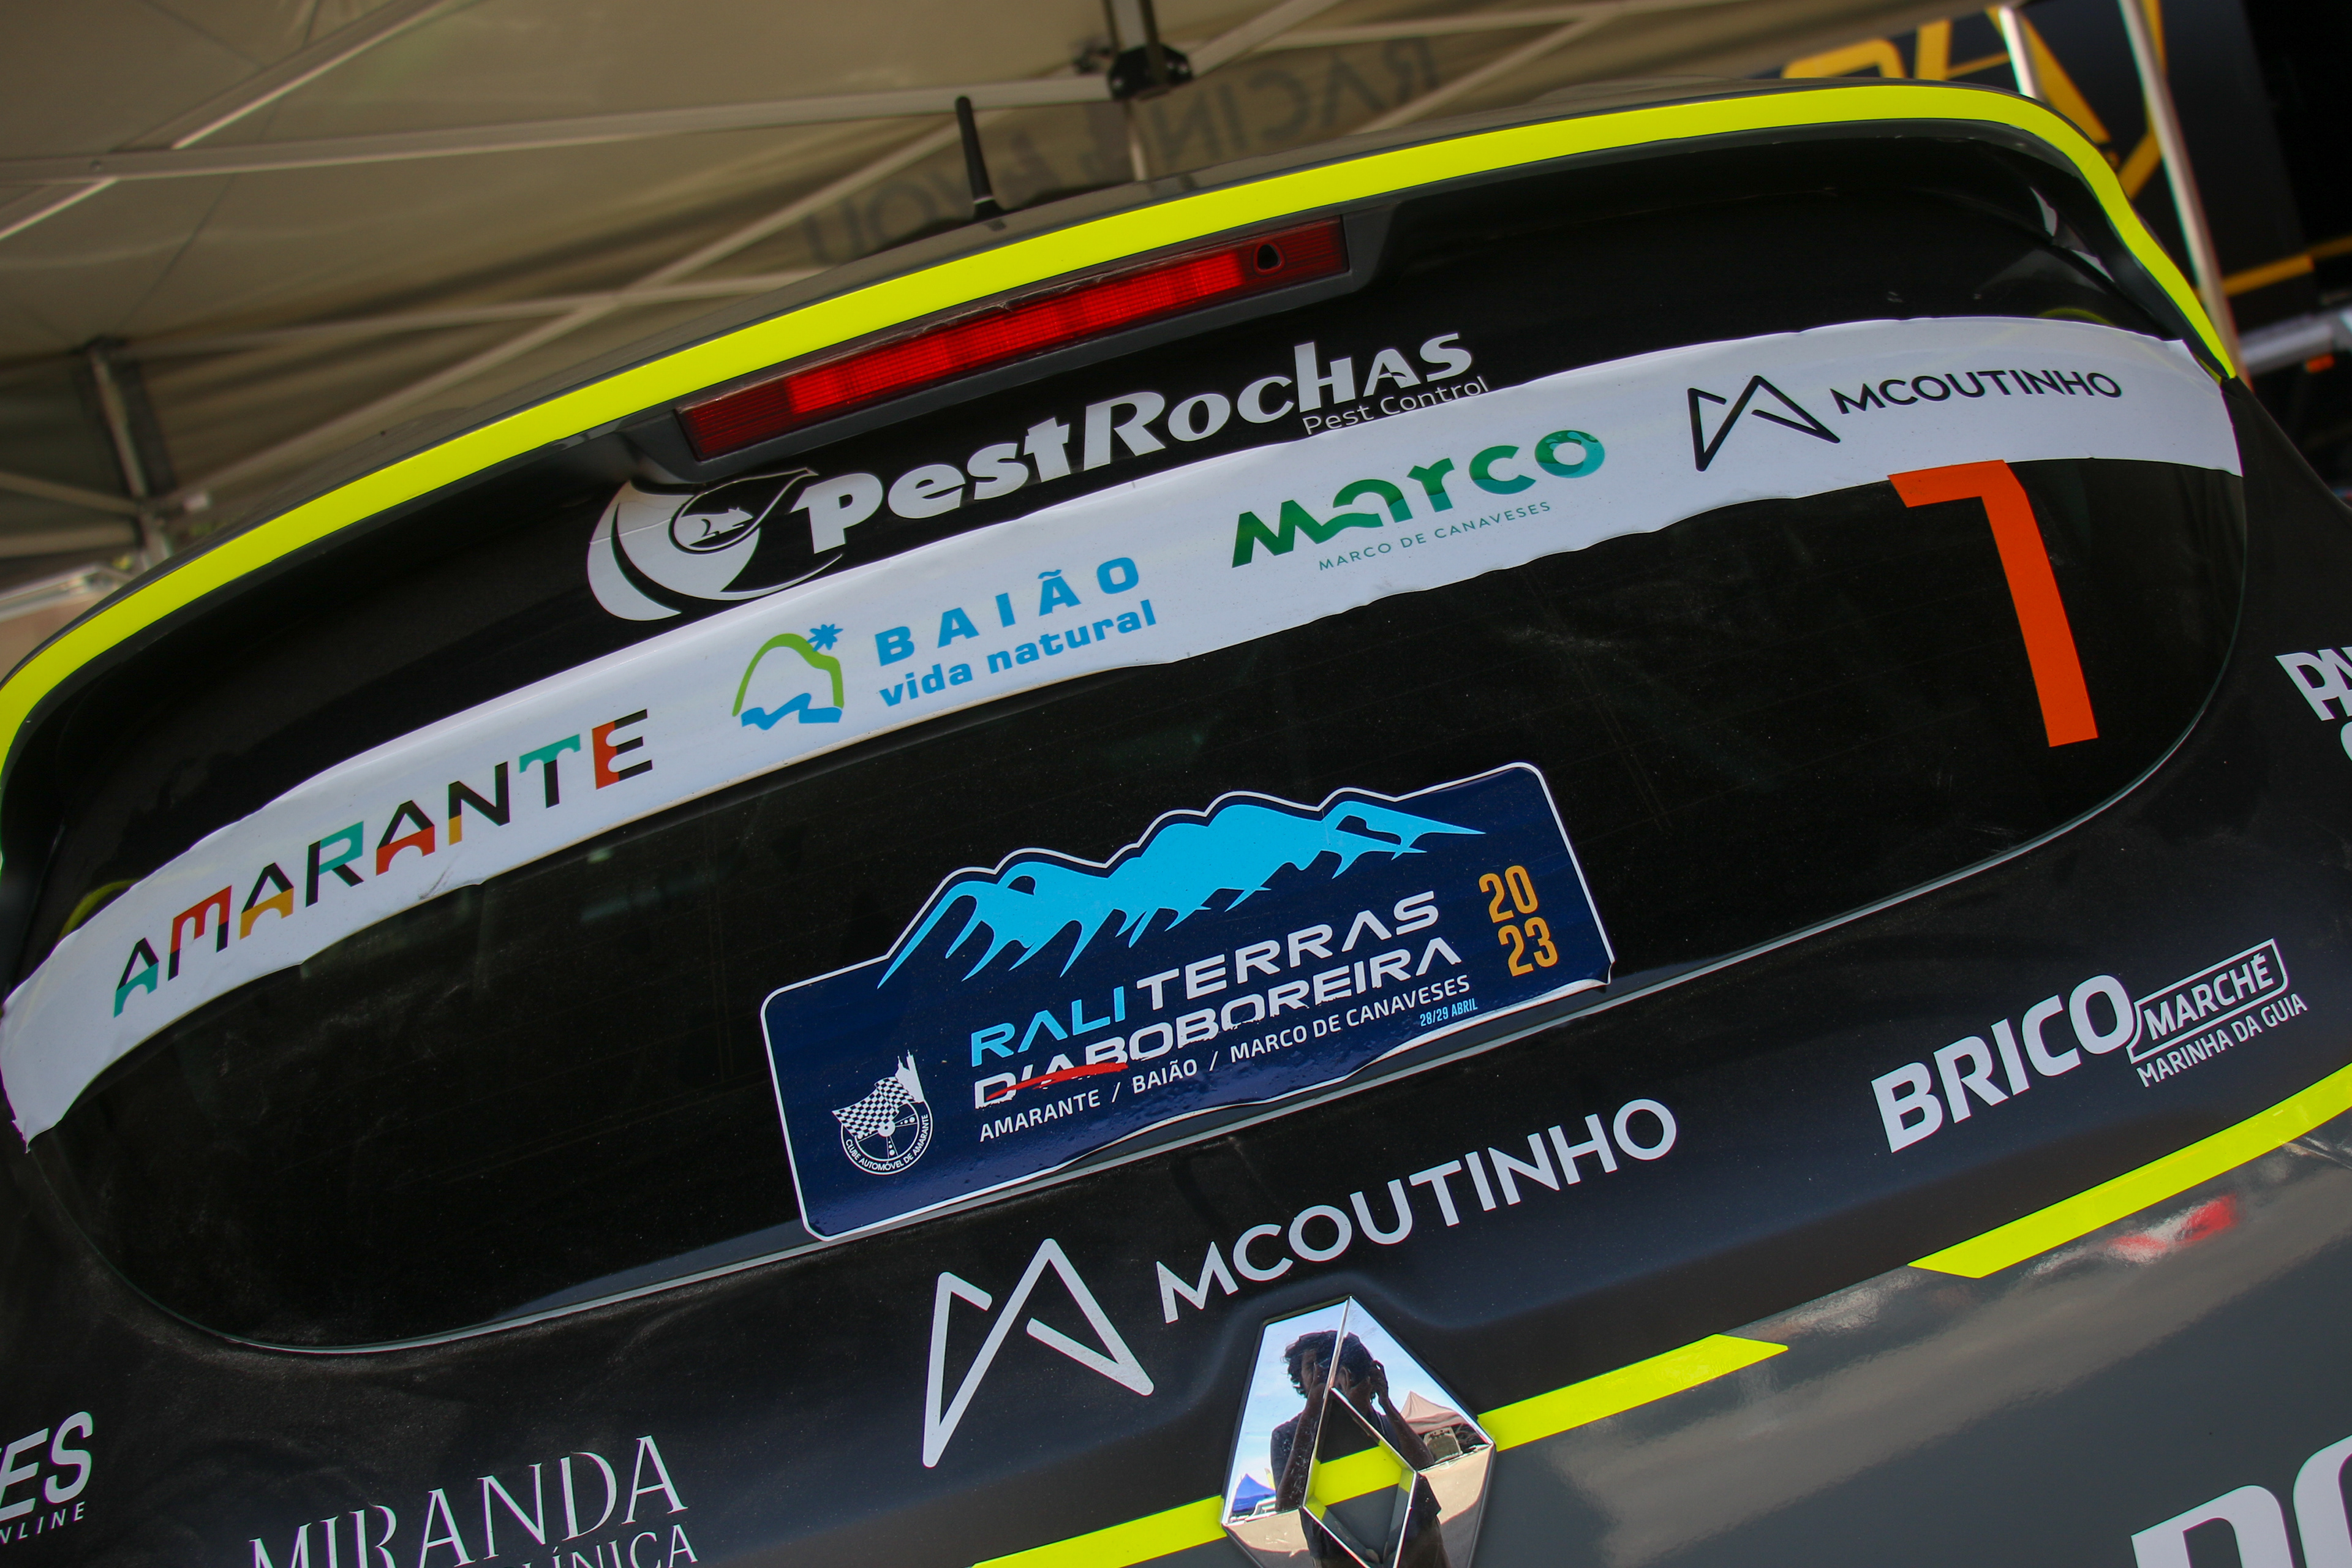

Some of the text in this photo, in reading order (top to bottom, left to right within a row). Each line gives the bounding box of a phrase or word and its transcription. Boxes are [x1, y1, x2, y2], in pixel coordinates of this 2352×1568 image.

[1302, 376, 1489, 435] Pest Control
[1830, 369, 2122, 415] MCOUTINHO
[1319, 501, 1551, 571] MARCO DE CANAVESES
[875, 557, 1139, 666] BAIÃO
[879, 599, 1156, 707] vida natural
[1887, 459, 2098, 747] 7
[2275, 646, 2352, 721] PA
[113, 709, 654, 1019] AMARANTE
[1479, 865, 1538, 923] 20
[971, 890, 1440, 1068] RALI TERRAS
[1498, 917, 1558, 977] 23
[979, 1089, 1101, 1142] AMARANTE
[1132, 1059, 1197, 1094] BAIÃO
[1230, 1025, 1308, 1063] MARCO
[1313, 1014, 1341, 1038] DE
[1346, 974, 1470, 1027] CANAVESES
[1419, 998, 1479, 1027] 28/29 ABRIL
[1871, 952, 2274, 1153] BRICO MARCHÉ
[2136, 993, 2308, 1088] MARINHA DA GUIA
[845, 1114, 929, 1172] CLUBE AUTOMÓVEL DE AMARANTE
[1156, 1098, 1677, 1324] MCOUTINHO
[0, 1411, 93, 1521] ES
